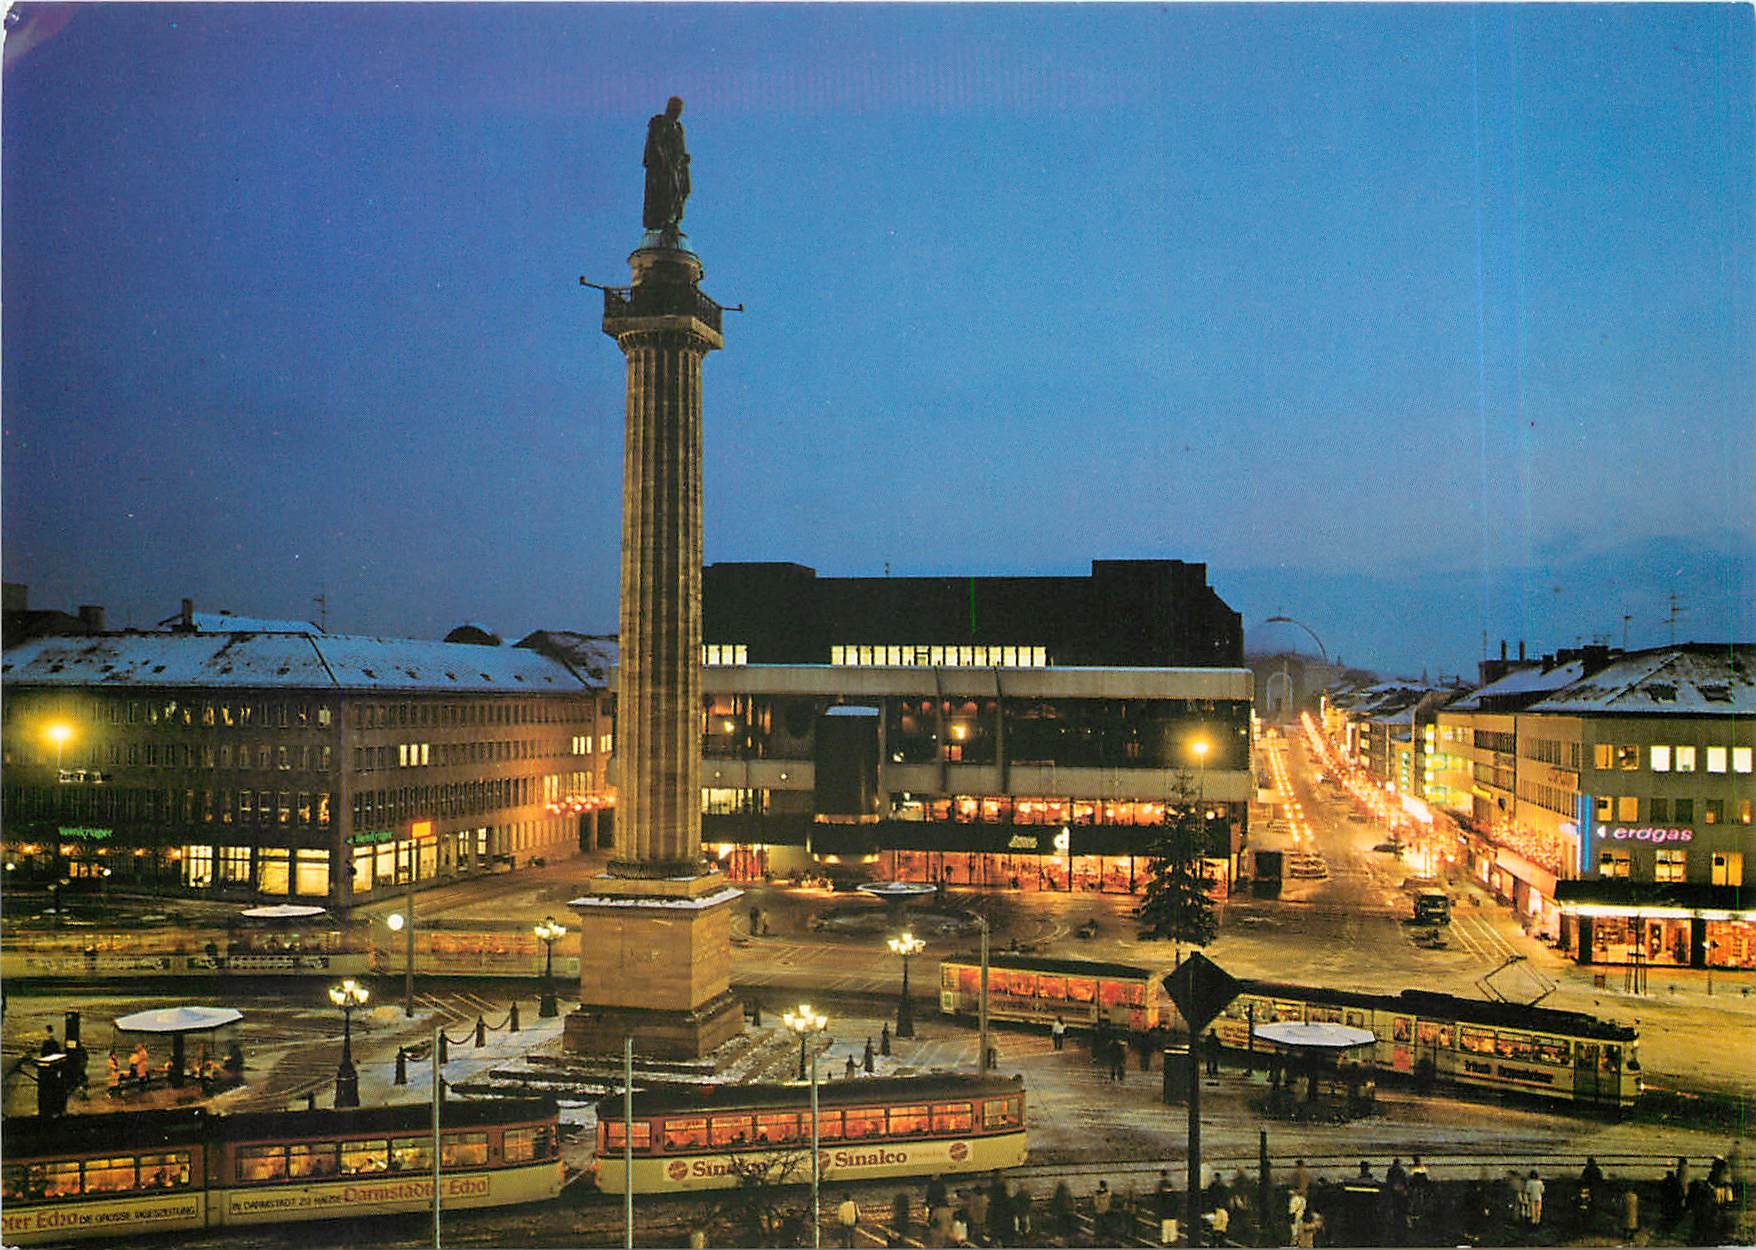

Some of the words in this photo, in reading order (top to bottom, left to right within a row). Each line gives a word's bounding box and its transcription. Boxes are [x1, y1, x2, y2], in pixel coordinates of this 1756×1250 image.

[1613, 827, 1693, 843] erdgas
[835, 1150, 907, 1168] Sinalco
[449, 1179, 487, 1195] Echo
[36, 1209, 79, 1229] Echo
